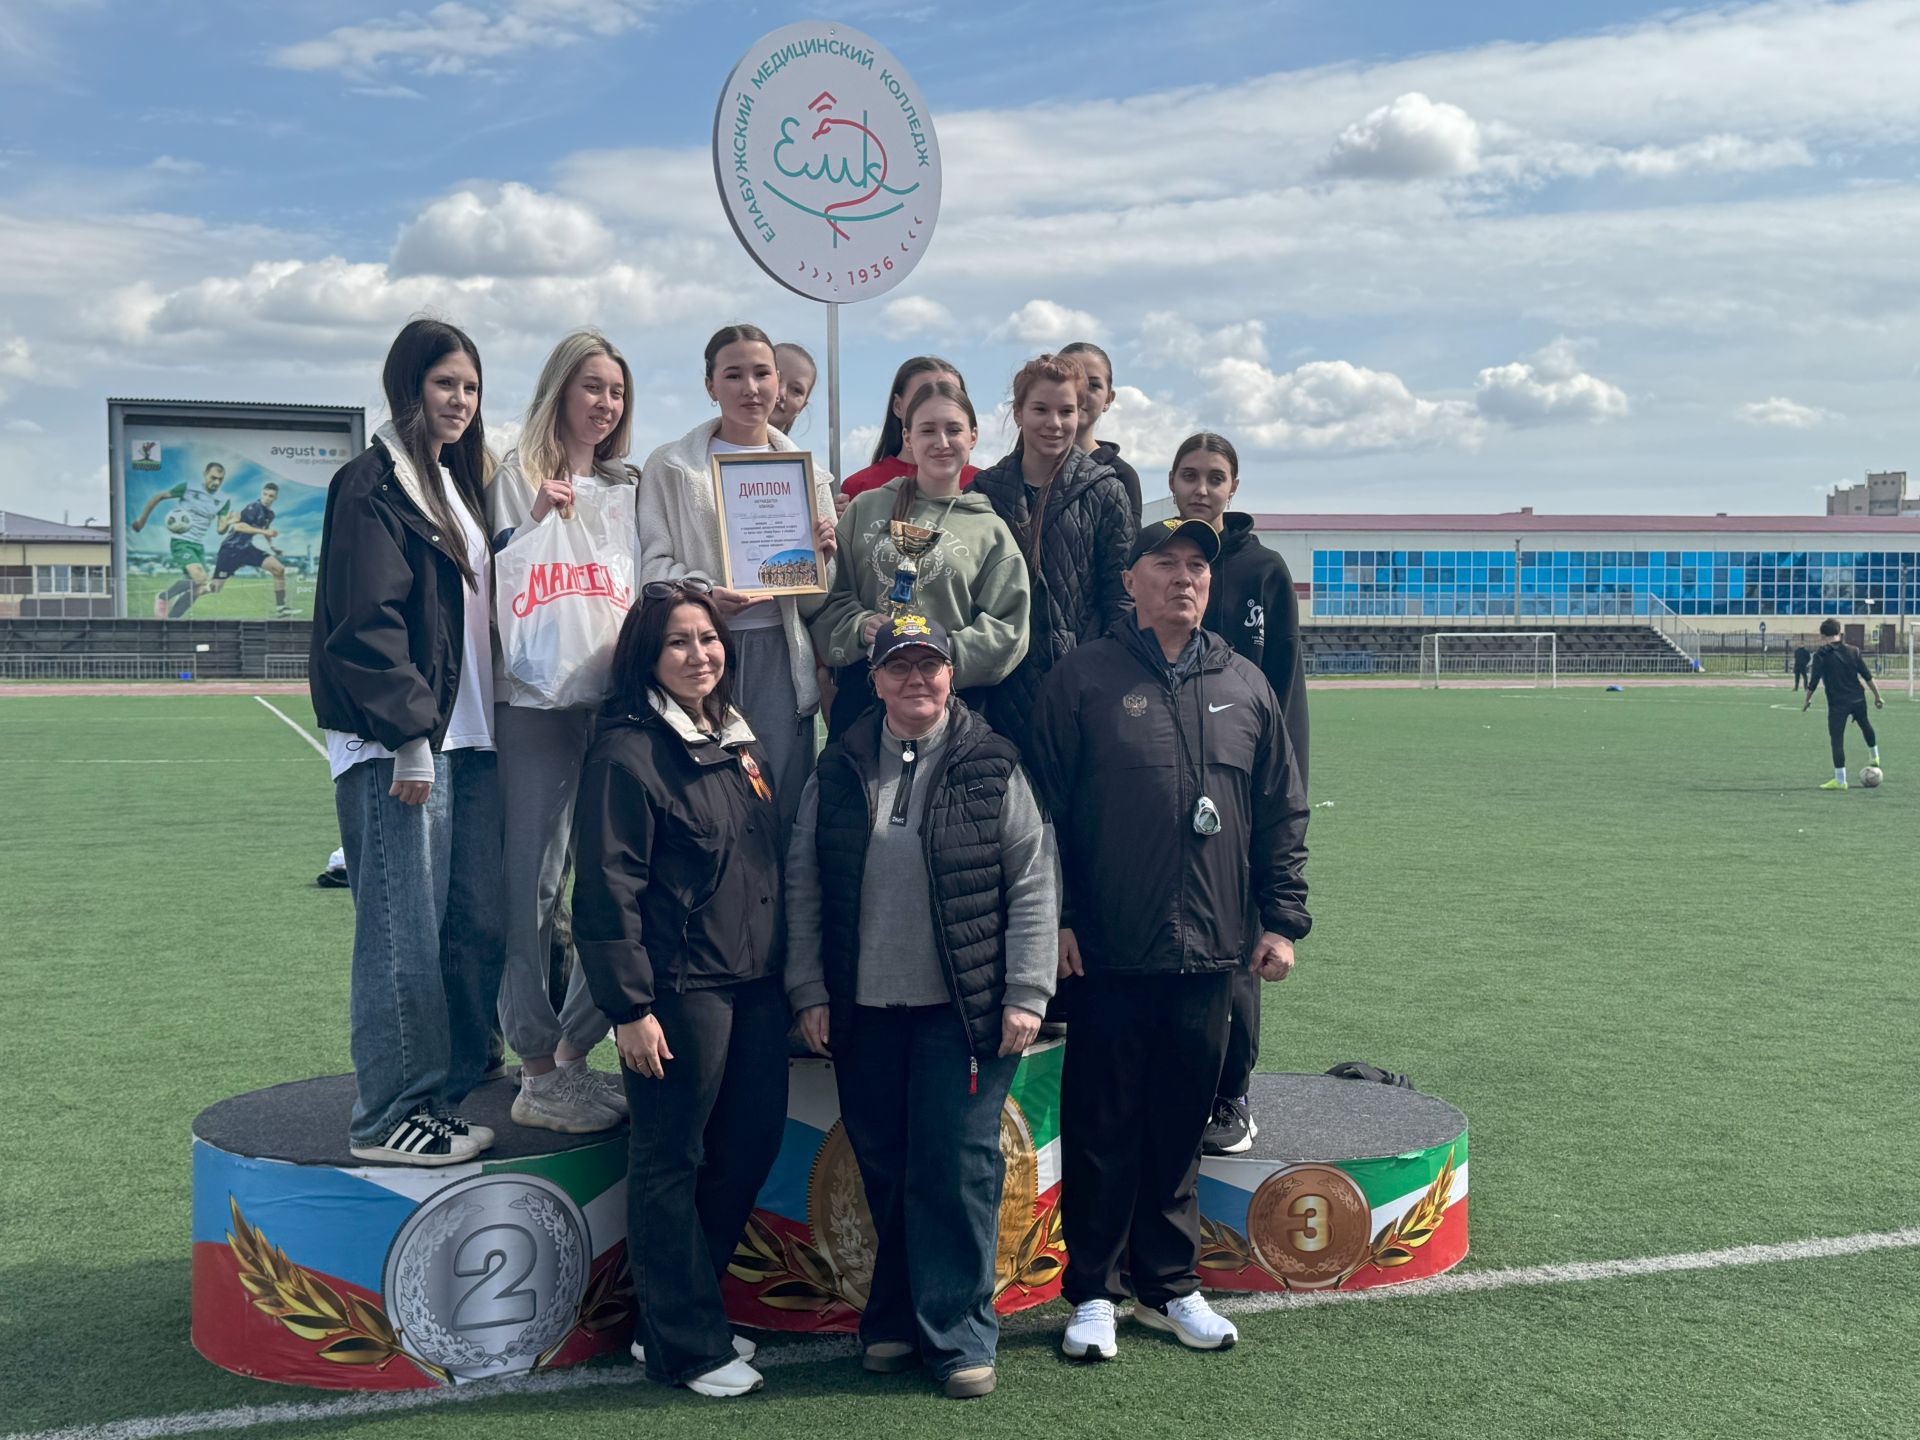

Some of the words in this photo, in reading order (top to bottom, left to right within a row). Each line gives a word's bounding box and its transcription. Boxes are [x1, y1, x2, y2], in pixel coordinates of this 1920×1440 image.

[751, 38, 875, 90] МЕДИЦИНСКИЙ
[879, 69, 930, 167] КОЛЛЕДЖ
[733, 92, 776, 243] ЕЛАБУЖСКИЙ
[847, 256, 894, 286] 1936
[271, 445, 315, 458] avgust
[738, 481, 791, 499] ДИПЛОМ
[863, 517, 970, 558] ATETIC
[1287, 1193, 1334, 1252] 3
[451, 1223, 538, 1332] 2
